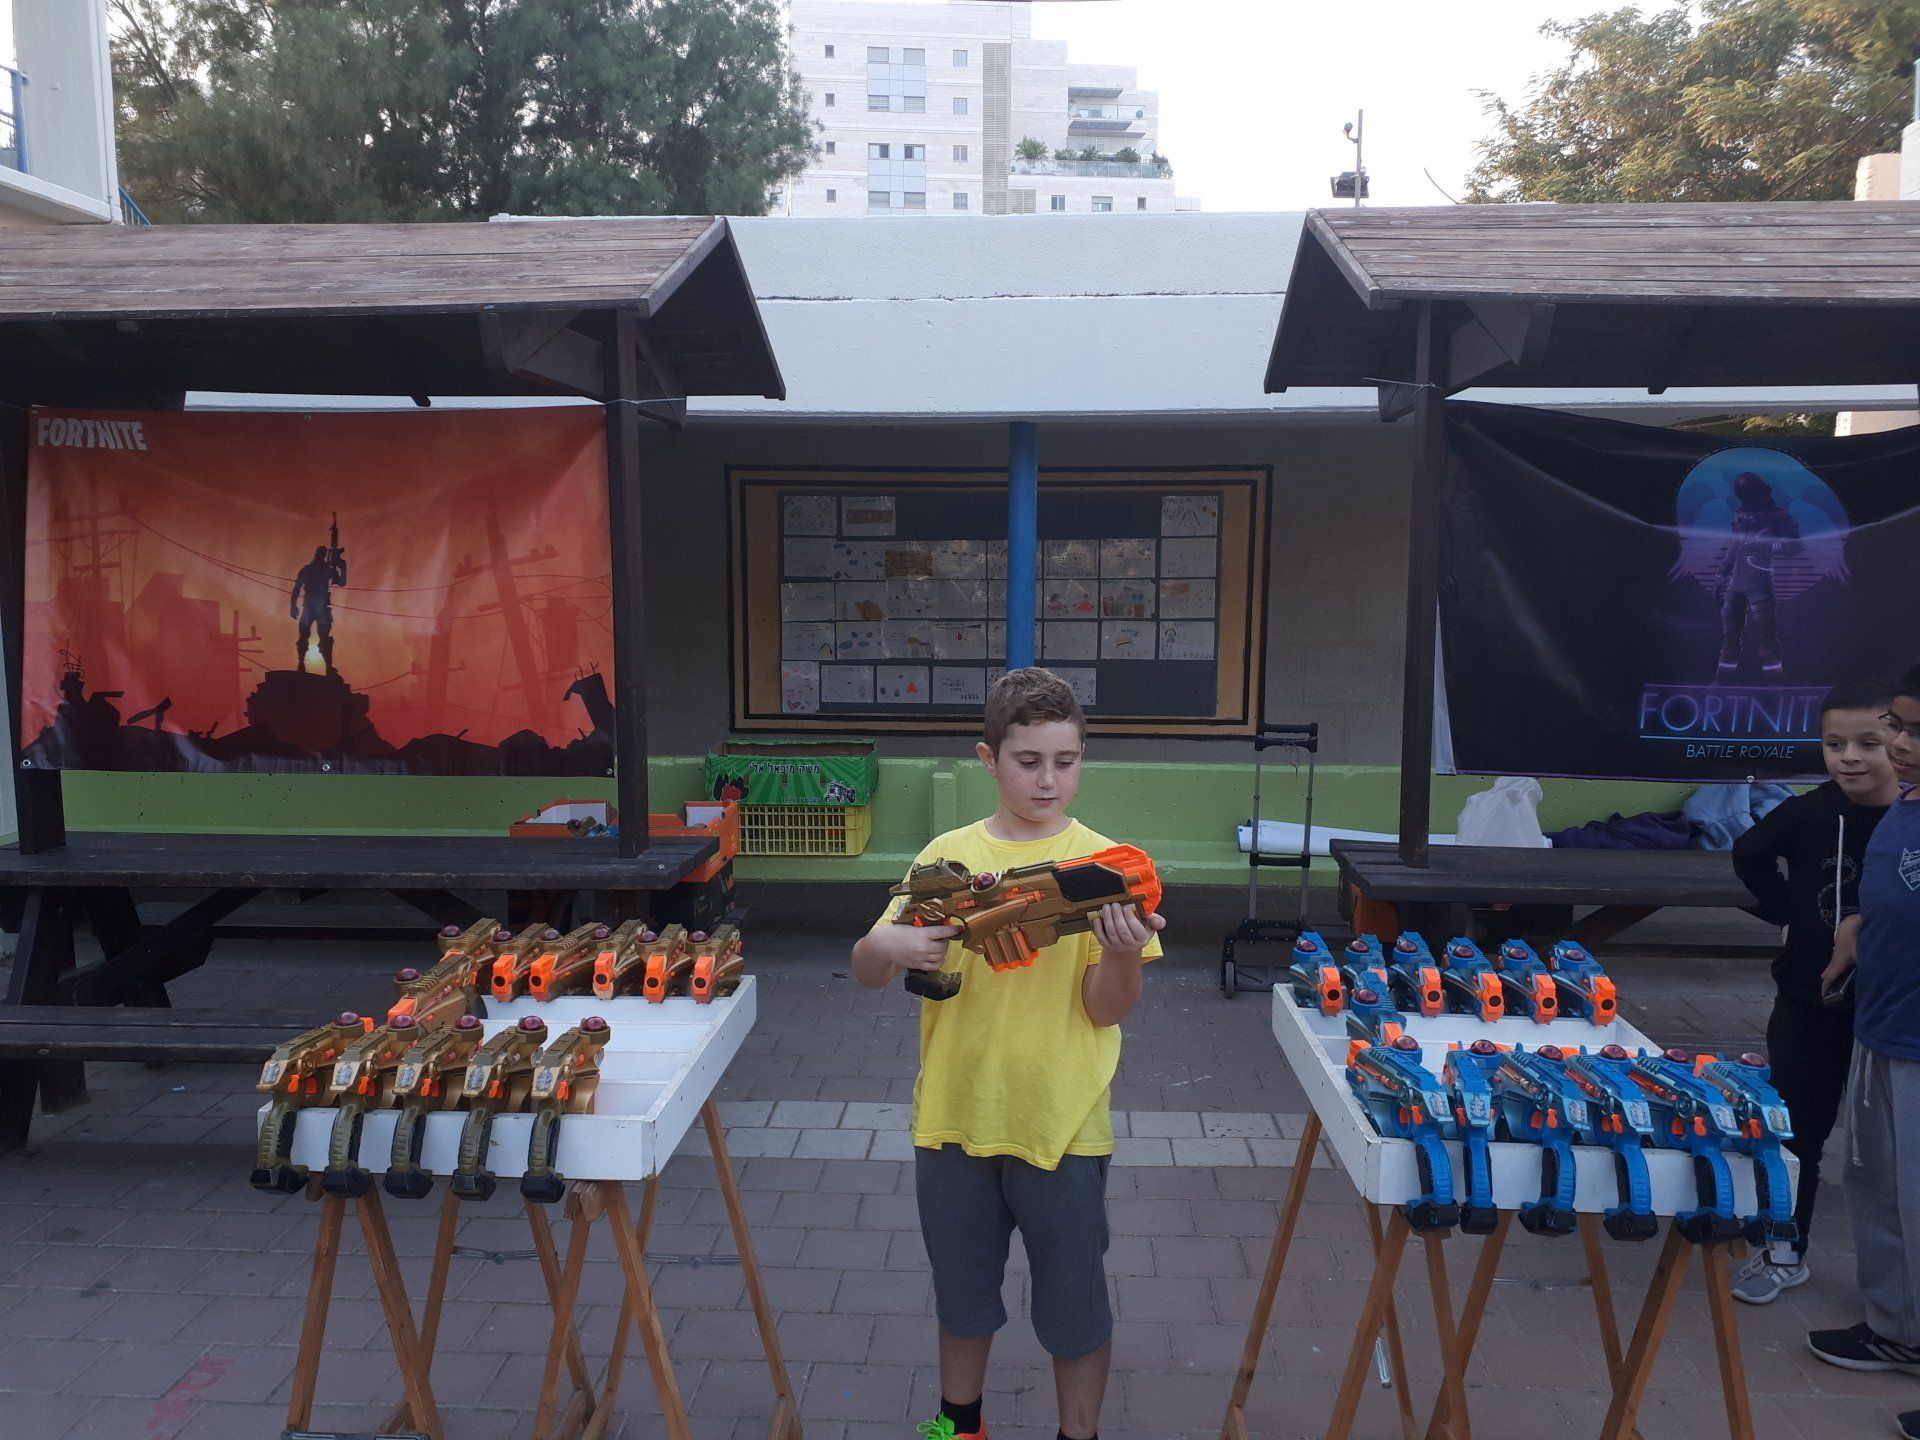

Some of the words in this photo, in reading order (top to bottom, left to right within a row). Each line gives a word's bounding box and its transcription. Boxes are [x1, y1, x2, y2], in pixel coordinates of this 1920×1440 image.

[37, 417, 148, 450] FORTNITE
[1639, 692, 1821, 733] FORTNIT
[1686, 744, 1735, 758] BATTLE
[1738, 745, 1795, 759] ROYALE
[749, 762, 765, 774] אלי
[767, 762, 795, 774] מיכאל
[799, 763, 820, 774] משק
